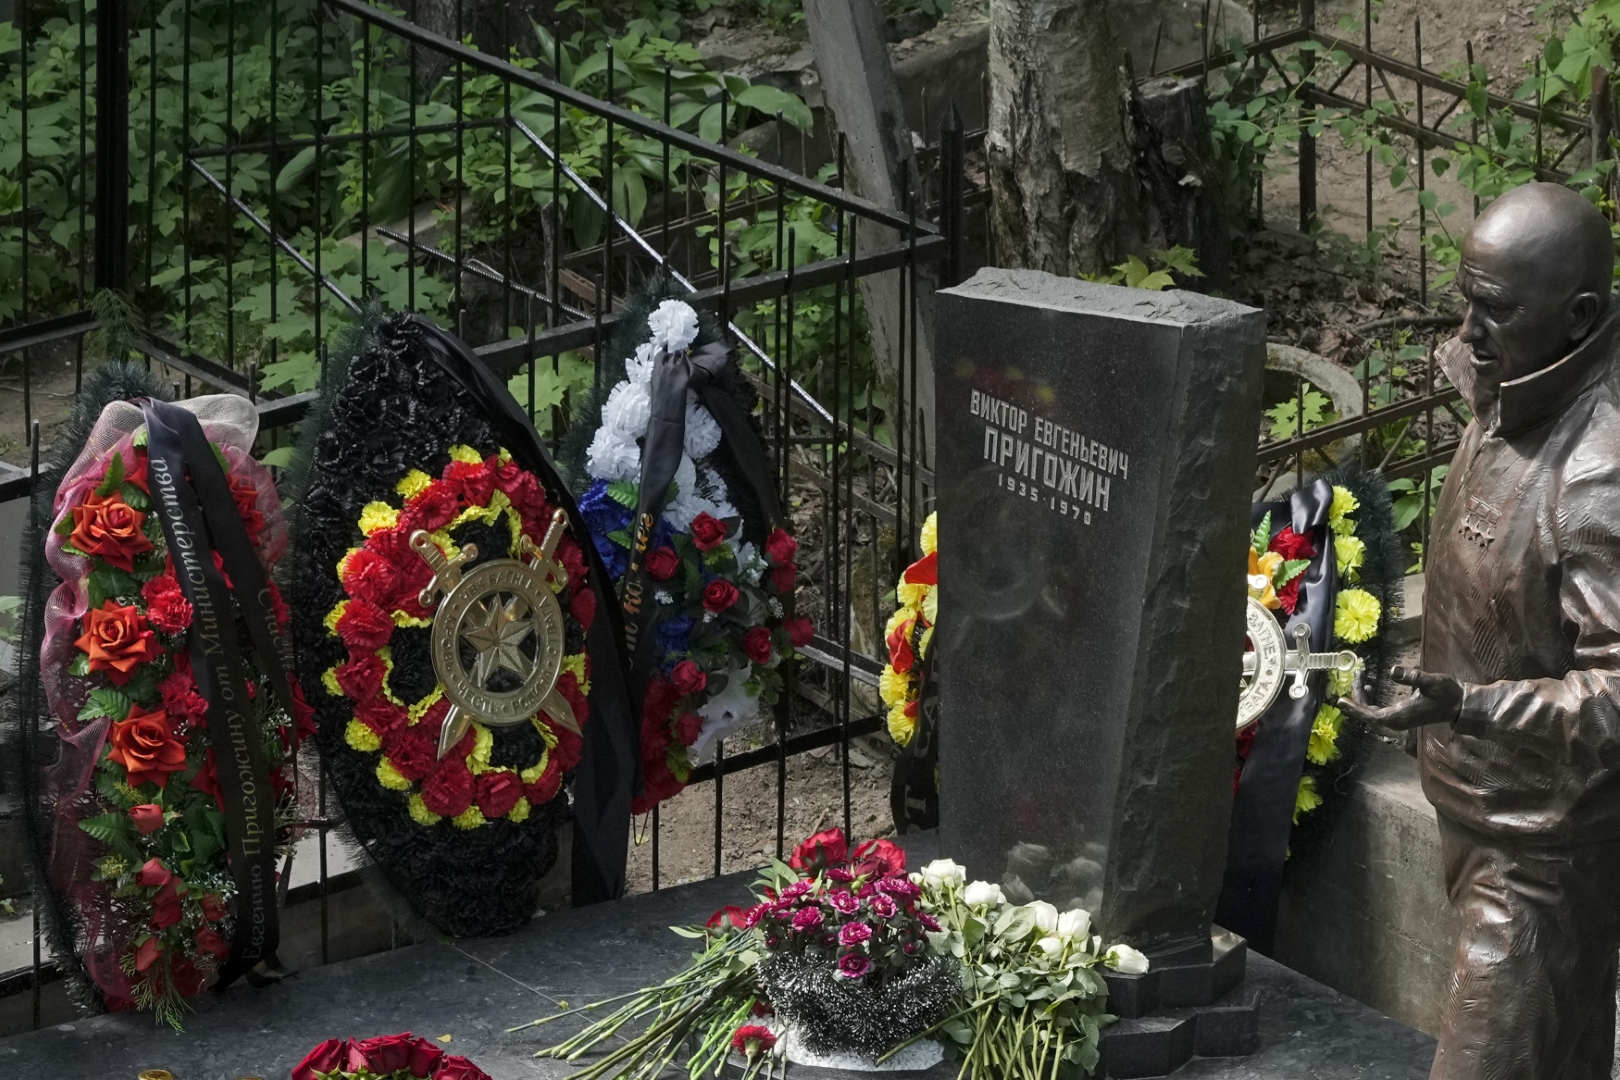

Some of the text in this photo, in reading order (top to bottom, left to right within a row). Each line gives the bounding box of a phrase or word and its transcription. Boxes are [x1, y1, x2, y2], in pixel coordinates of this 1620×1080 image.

[970, 388, 1129, 480] ВИКТОР ЕВГЕНЬЕВИЧ
[984, 425, 1111, 512] ПРИГОЖИН
[998, 472, 1091, 526] 1935 1970
[150, 456, 265, 960] Евгению Пригожину от Министерства
[1239, 681, 1272, 718] ТВАГА
